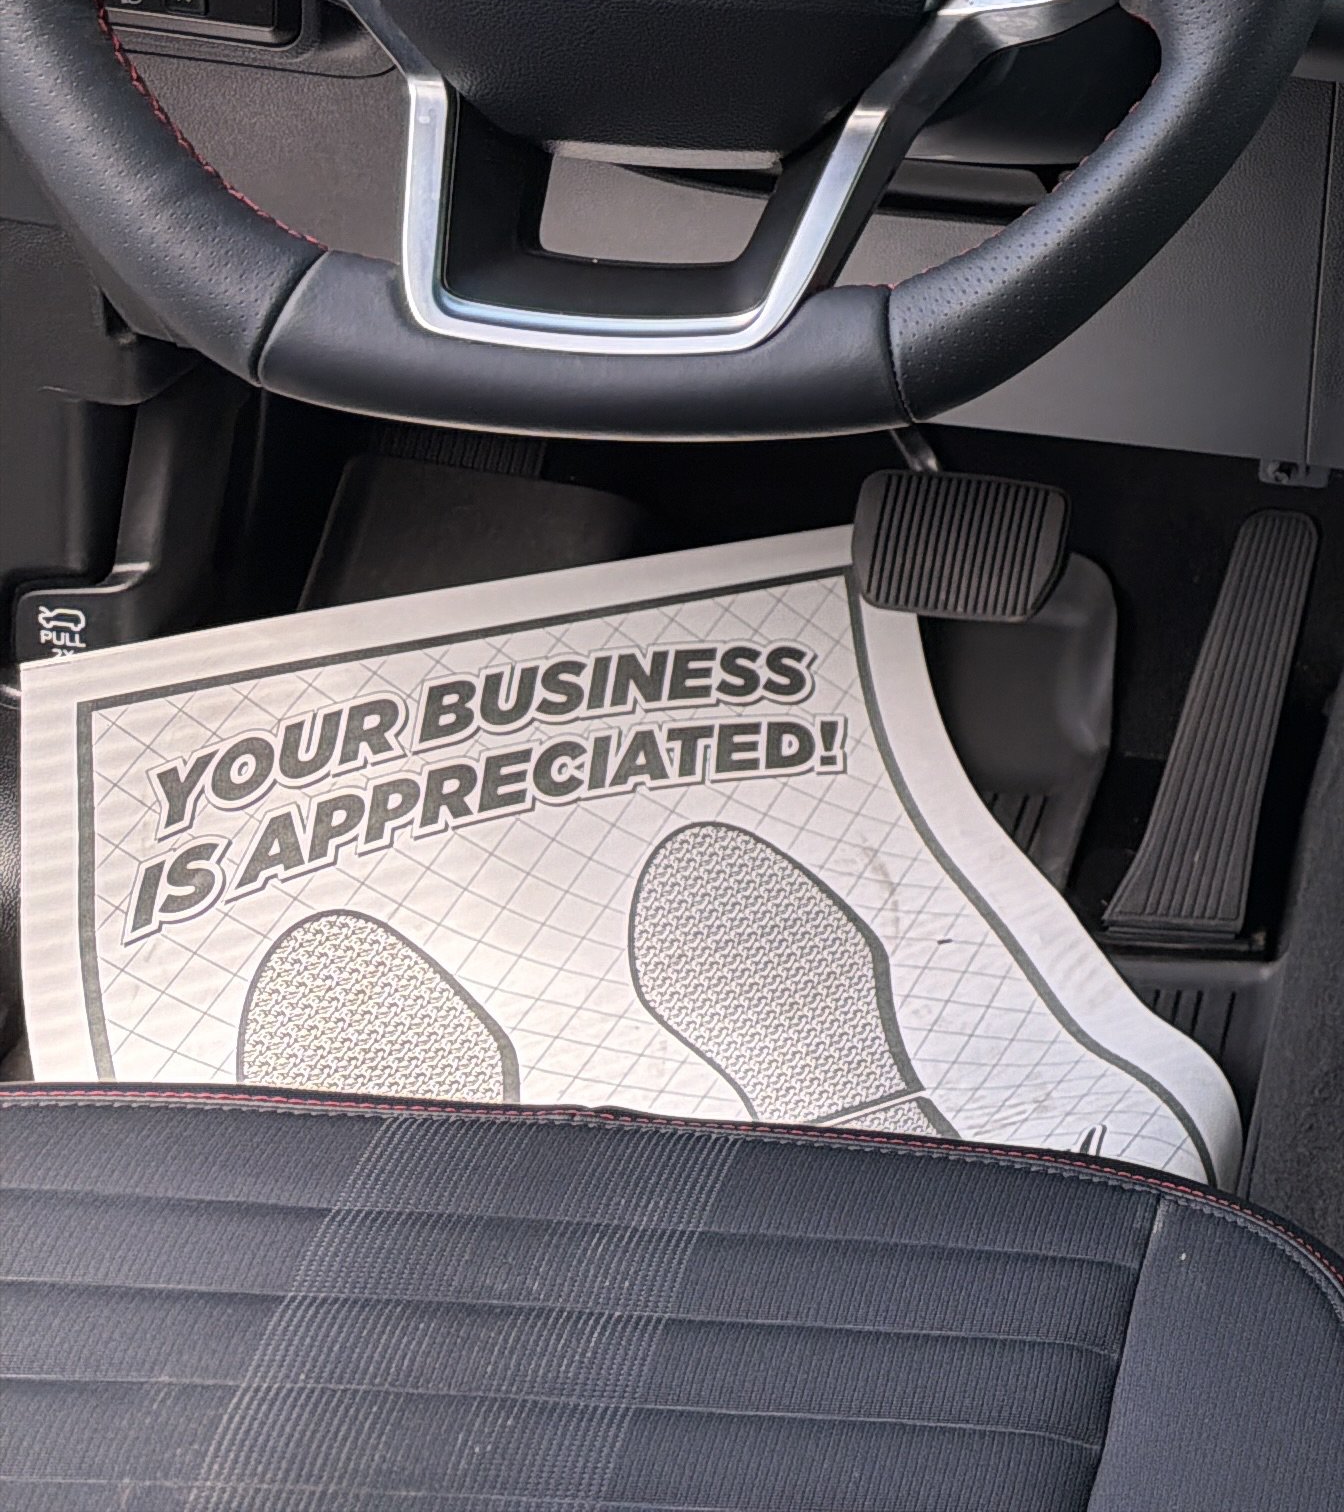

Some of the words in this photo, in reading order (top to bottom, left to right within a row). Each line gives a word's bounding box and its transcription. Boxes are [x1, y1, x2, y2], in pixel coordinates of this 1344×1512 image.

[40, 629, 86, 648] PULL
[130, 843, 221, 935] IS
[235, 720, 843, 891] APPRECIATED!
[155, 697, 403, 829] YOUR
[421, 648, 808, 739] BUSINESS
